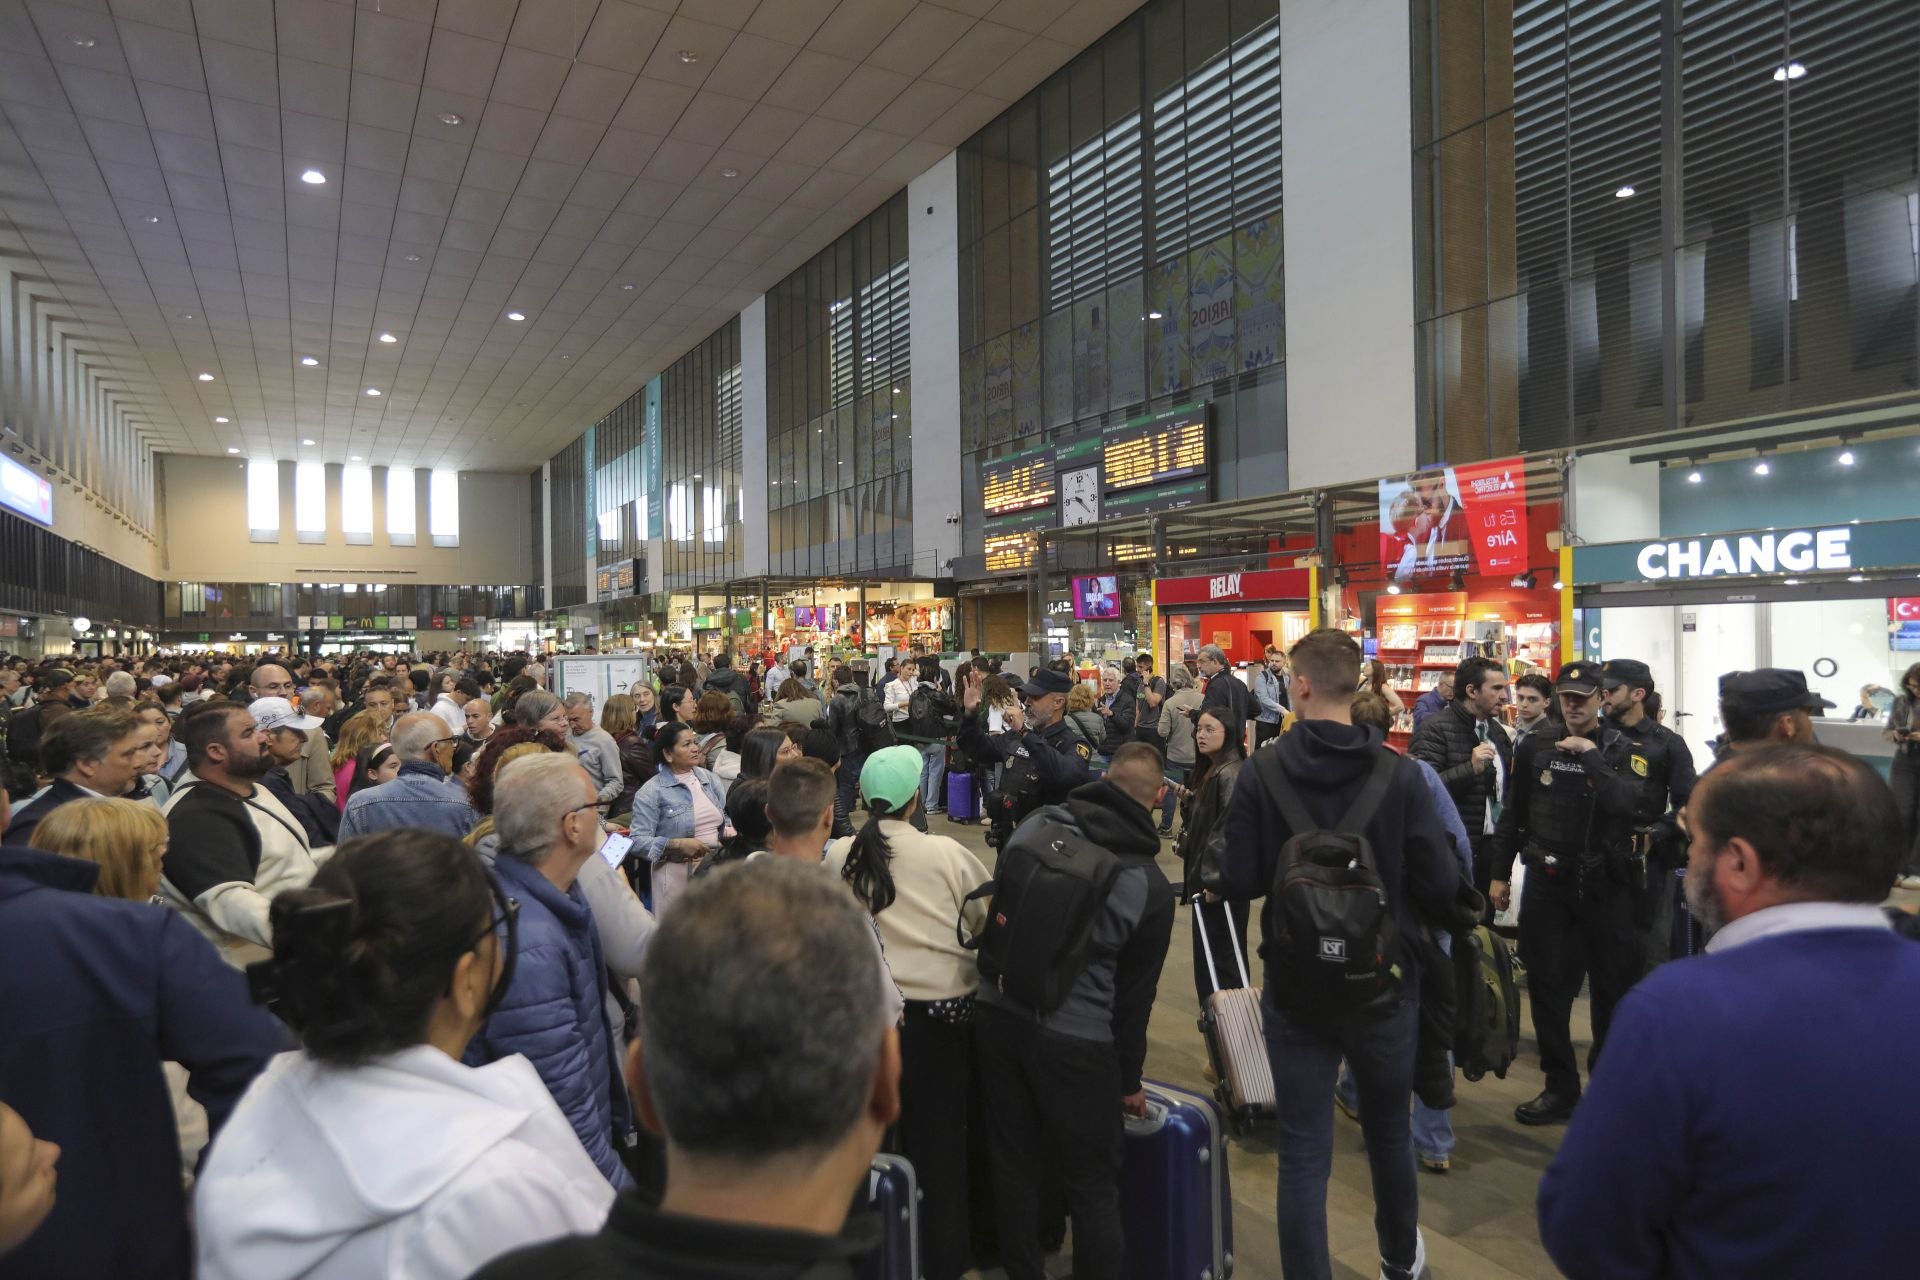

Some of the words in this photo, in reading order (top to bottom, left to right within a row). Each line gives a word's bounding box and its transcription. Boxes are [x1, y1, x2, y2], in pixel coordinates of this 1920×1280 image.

[1076, 475, 1083, 484] 12
[1090, 494, 1095, 502] 3
[1065, 499, 1071, 507] 9
[1078, 517, 1083, 525] 6
[1637, 528, 1851, 579] CHANGE
[1210, 573, 1241, 599] RELAY
